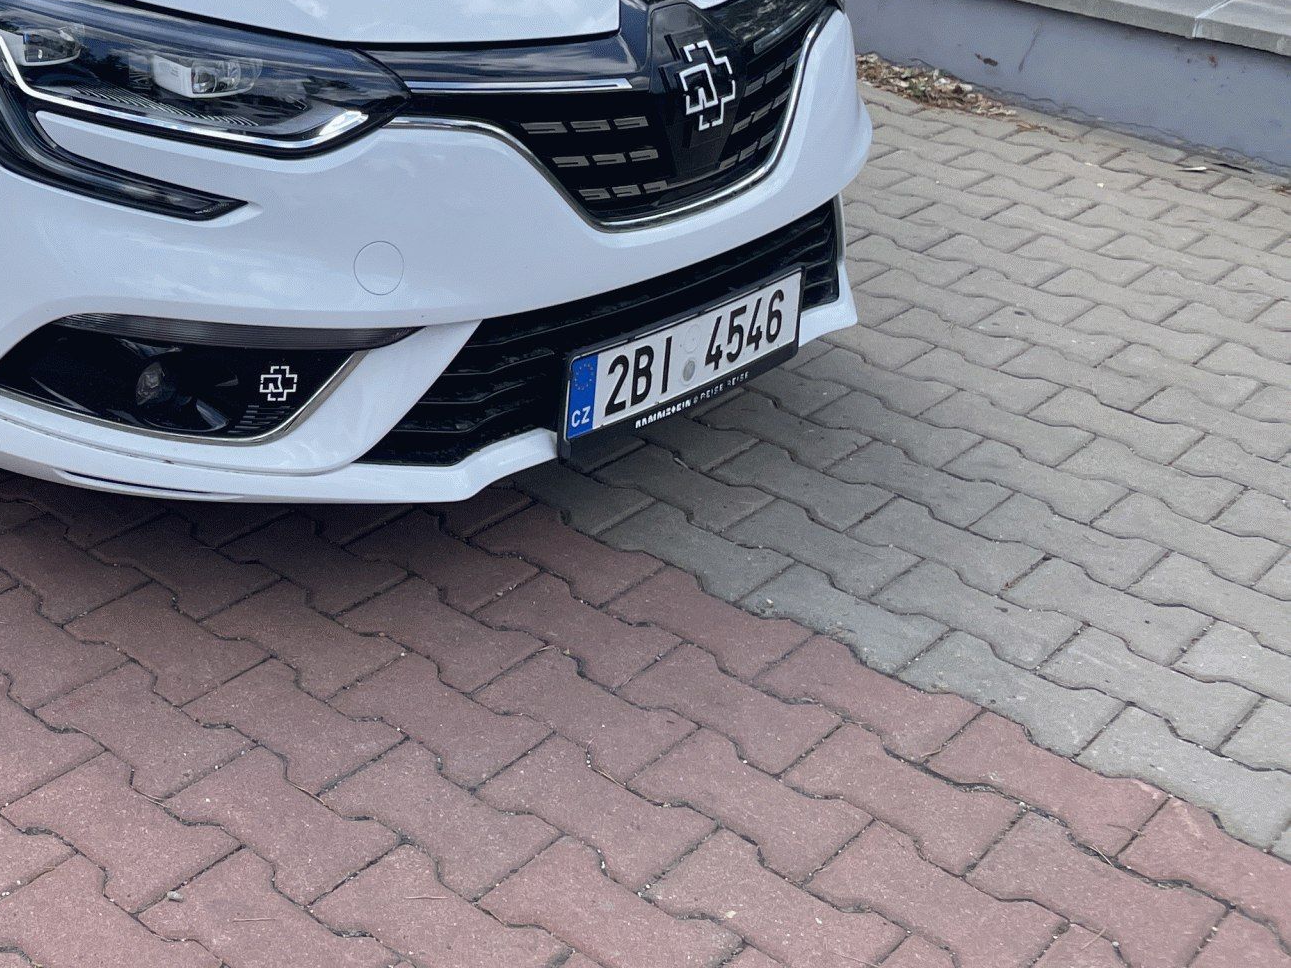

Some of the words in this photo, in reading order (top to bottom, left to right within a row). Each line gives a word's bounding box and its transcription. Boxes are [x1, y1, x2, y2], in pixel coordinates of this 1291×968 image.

[604, 336, 673, 417] 2BI
[704, 289, 785, 371] 4546
[571, 405, 592, 428] CZ
